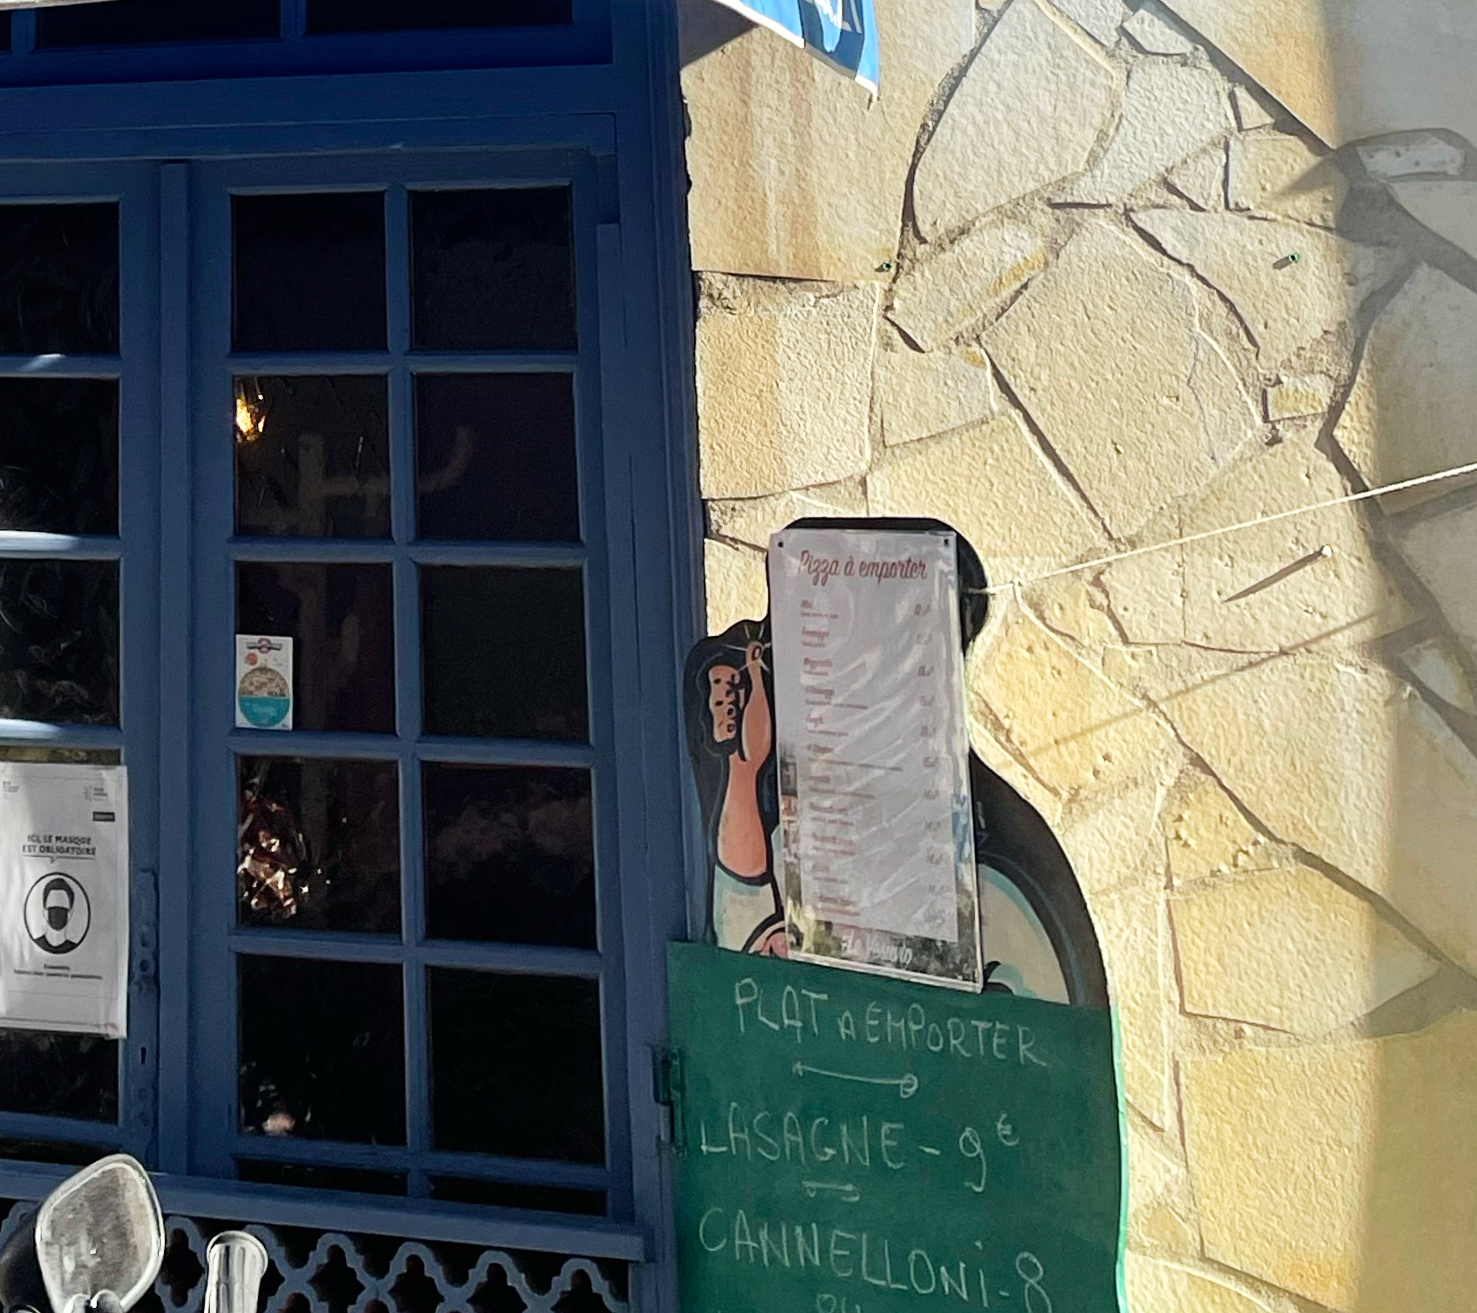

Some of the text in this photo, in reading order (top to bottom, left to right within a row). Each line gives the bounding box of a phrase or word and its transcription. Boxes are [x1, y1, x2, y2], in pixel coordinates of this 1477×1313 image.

[798, 549, 840, 586] Pizza
[858, 555, 928, 586] emporter
[734, 977, 828, 1043] PLAT
[865, 1001, 1047, 1067] EMPORTER
[700, 1102, 905, 1170] LASAGNE
